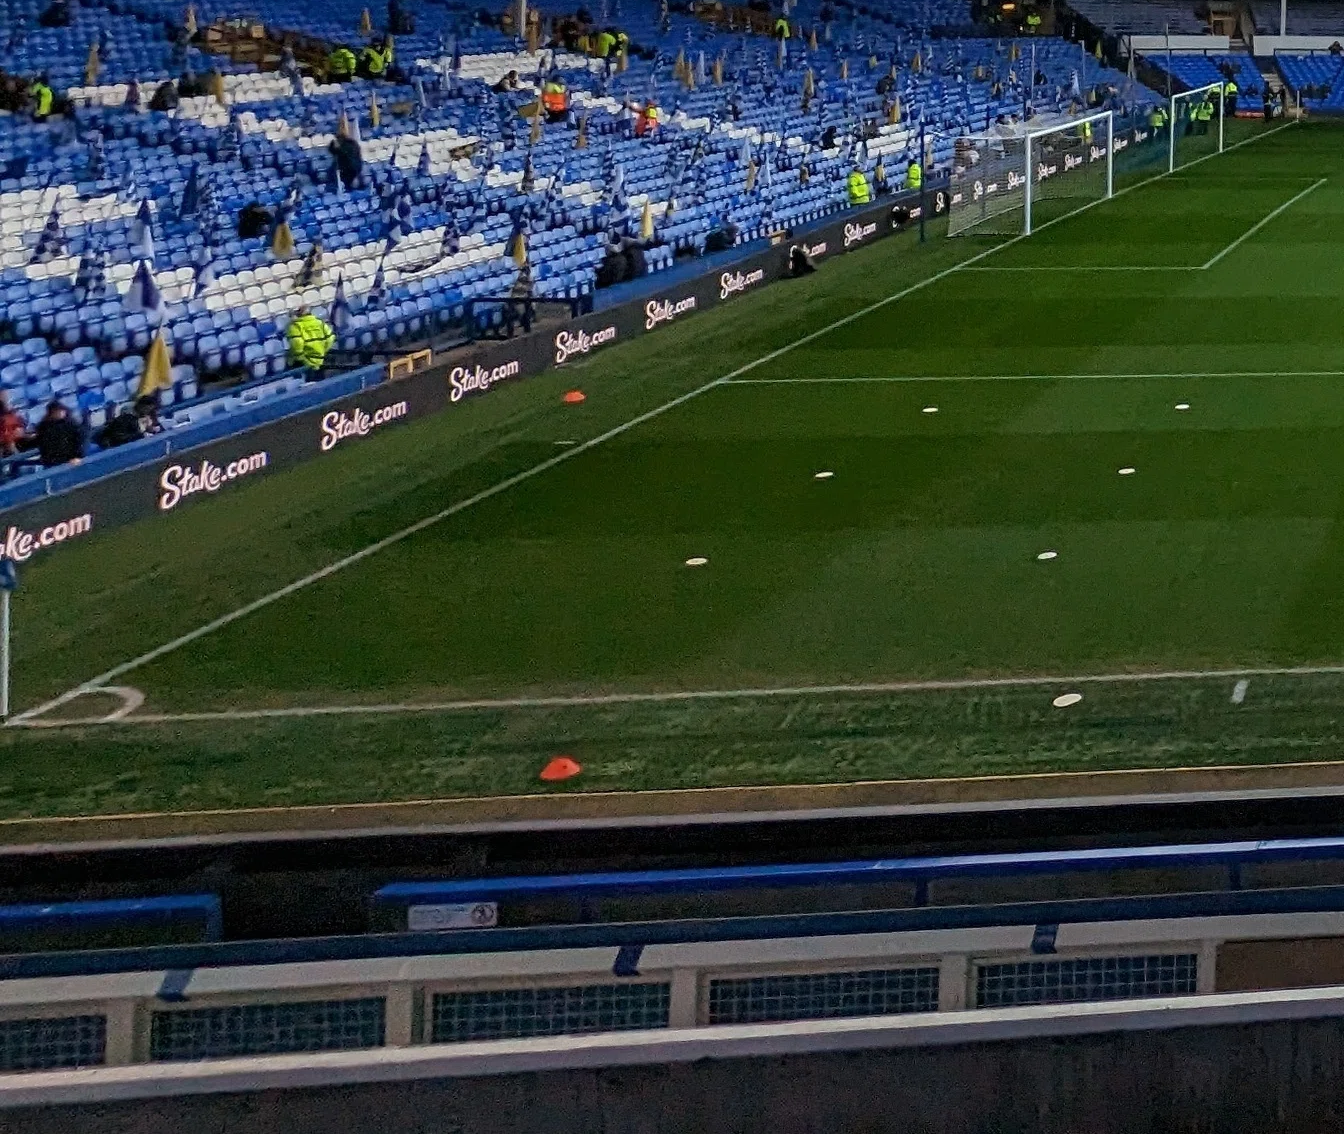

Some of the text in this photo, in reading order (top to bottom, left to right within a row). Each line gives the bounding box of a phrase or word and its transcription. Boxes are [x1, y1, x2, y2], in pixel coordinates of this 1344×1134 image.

[646, 296, 696, 329] Stake.com
[555, 325, 616, 364] Stake.com
[450, 359, 519, 402] Stake.com
[321, 401, 407, 451] Stake.com
[160, 451, 268, 510] Stake.com
